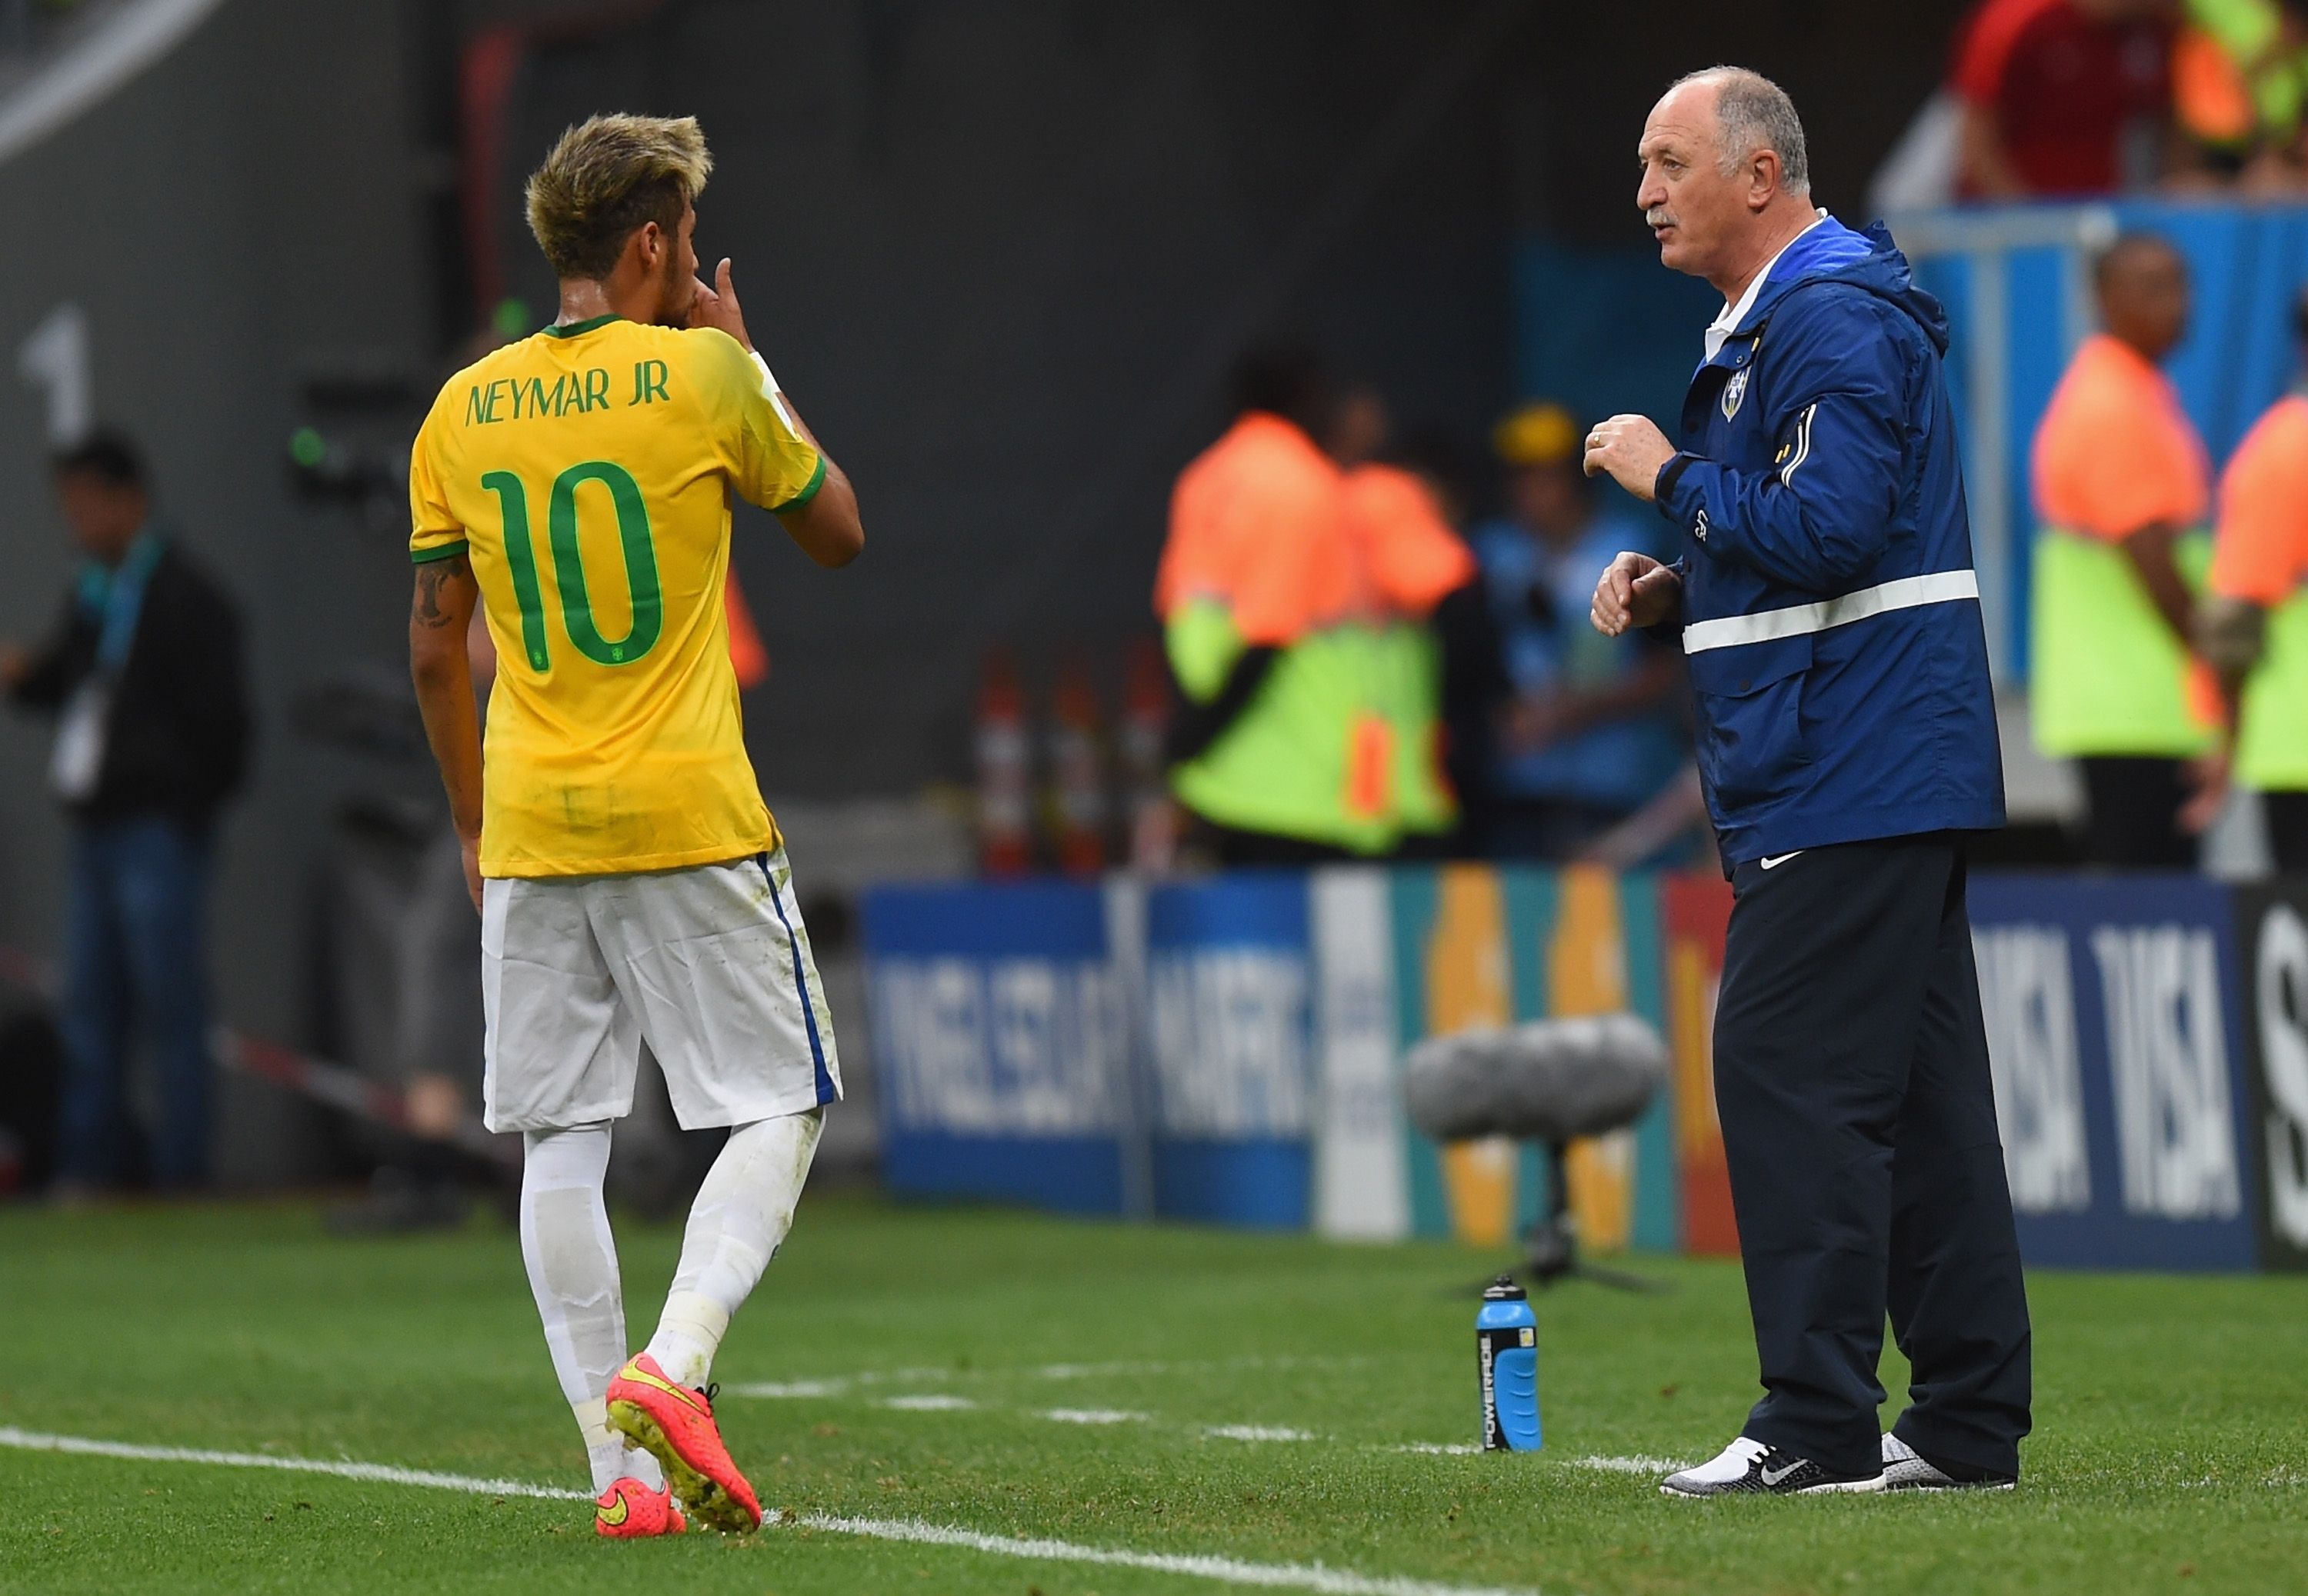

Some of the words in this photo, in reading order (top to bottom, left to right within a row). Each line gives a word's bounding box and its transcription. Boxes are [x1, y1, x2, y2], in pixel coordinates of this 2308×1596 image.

[465, 368, 610, 428] NEYMAR
[627, 359, 671, 407] JR
[481, 459, 665, 674] 10
[2088, 925, 2243, 1223] VISA
[1479, 1337, 1497, 1449] POWERADE
